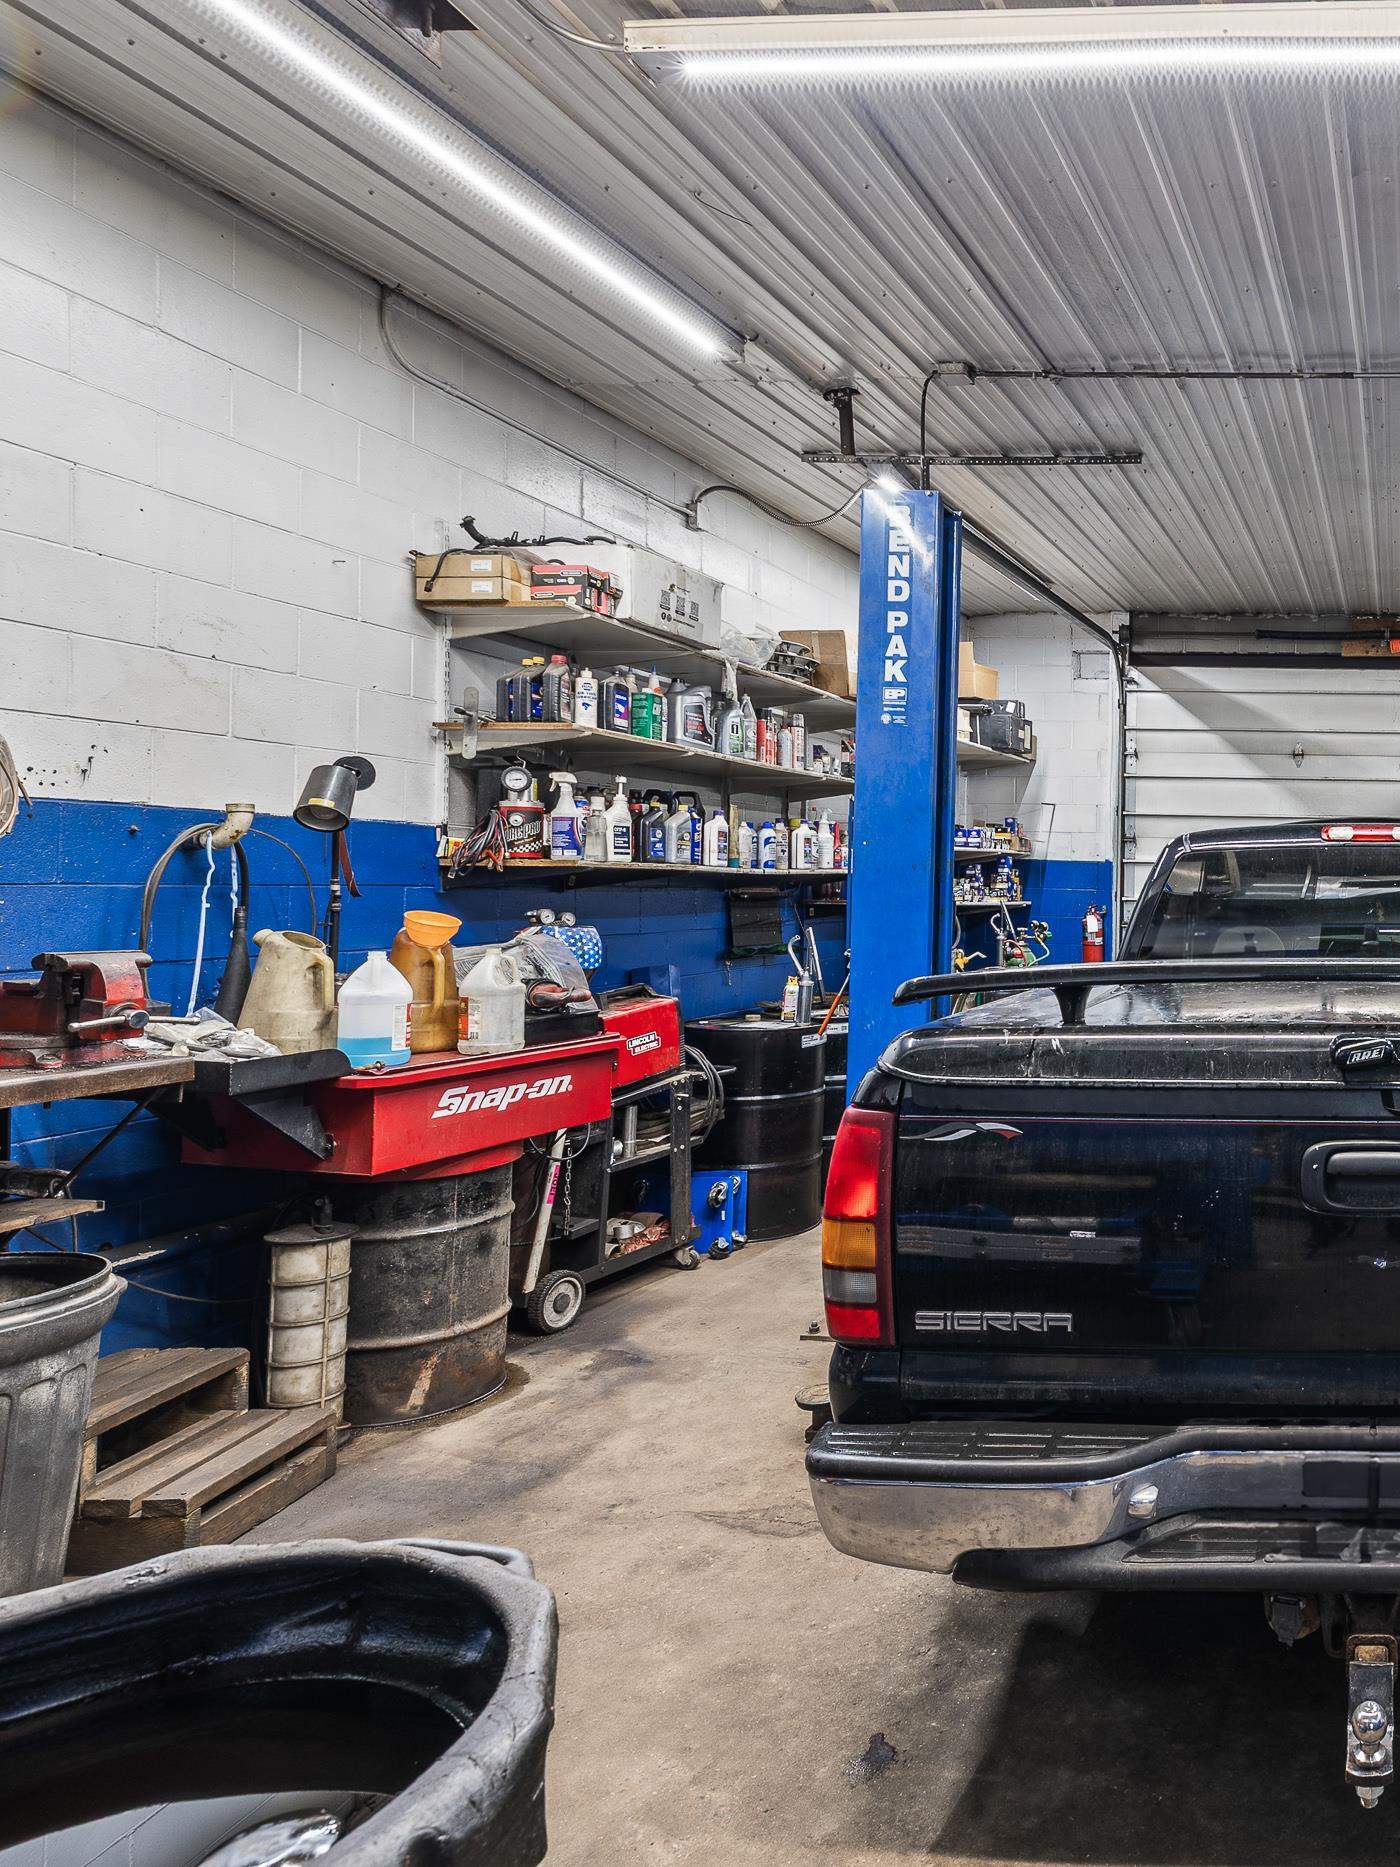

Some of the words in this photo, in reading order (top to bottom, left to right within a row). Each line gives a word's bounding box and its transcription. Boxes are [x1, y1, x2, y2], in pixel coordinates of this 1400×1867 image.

[884, 610, 909, 683] PAK
[628, 1033, 656, 1049] LINCOLN
[634, 1040, 660, 1053] ELECTRIC
[431, 1074, 573, 1119] Snap-on
[914, 1310, 1073, 1332] SIERRA
